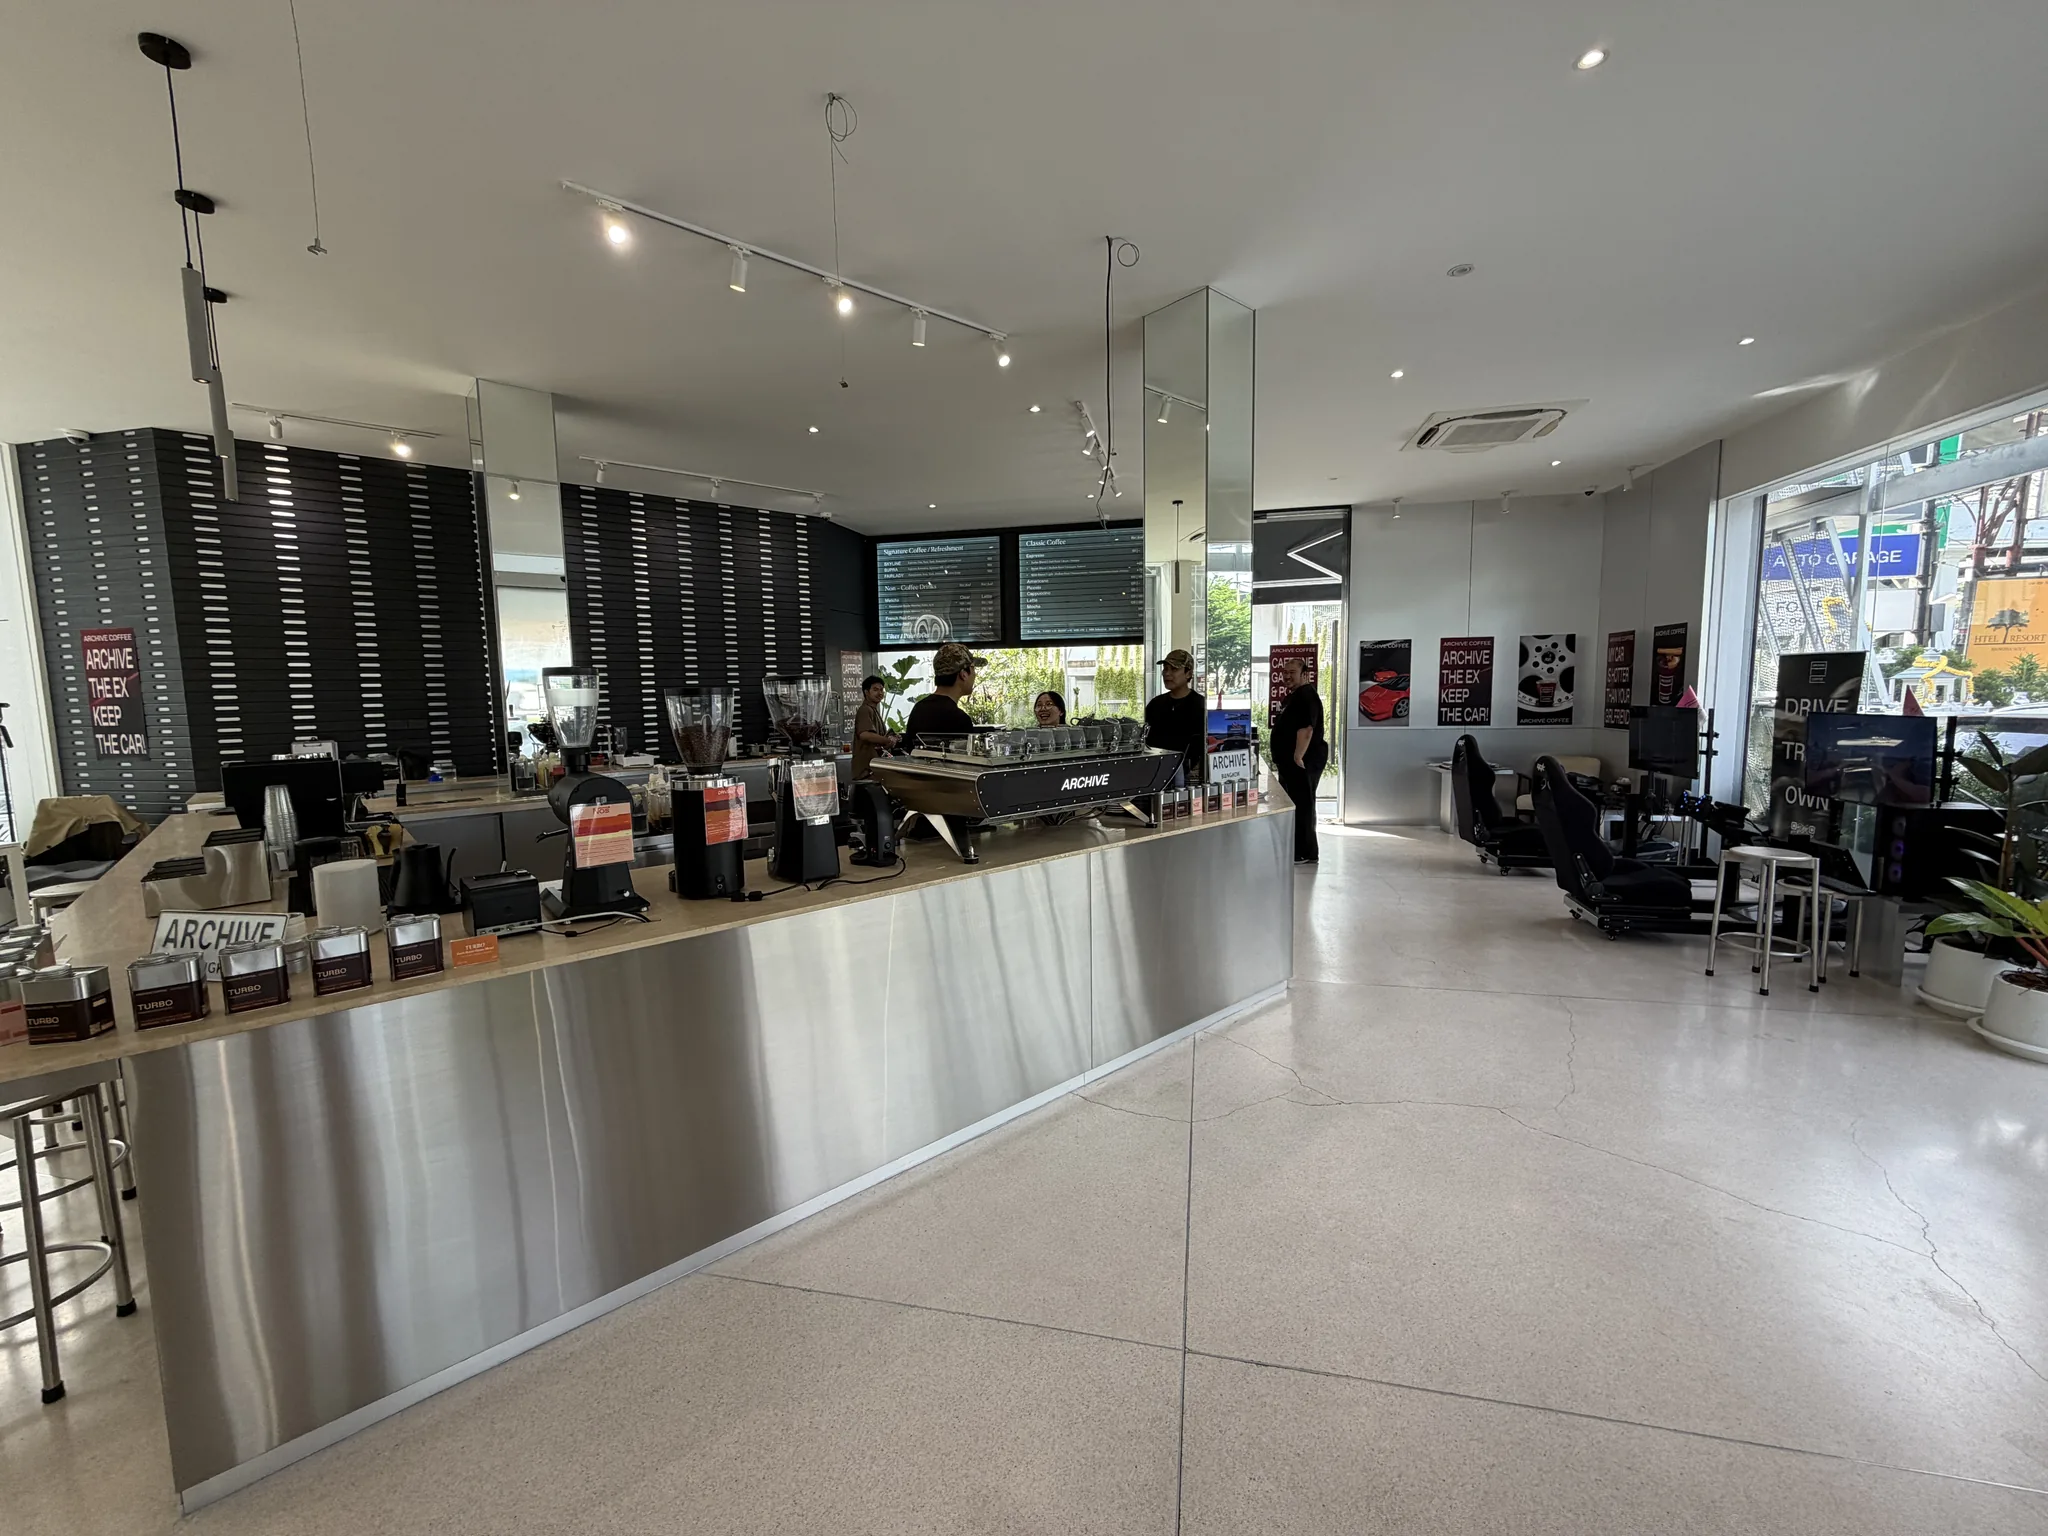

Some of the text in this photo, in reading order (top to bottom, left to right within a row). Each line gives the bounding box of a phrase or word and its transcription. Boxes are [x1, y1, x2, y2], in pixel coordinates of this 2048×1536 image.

[1025, 538, 1067, 547] Classic Coffee
[883, 548, 908, 556] Signature
[908, 546, 926, 554] Coffee
[1773, 553, 1821, 567] ATO
[108, 633, 132, 641] COFFEE
[1670, 627, 1686, 635] COFFEE
[2010, 633, 2047, 642] RESORT
[86, 647, 134, 670] ARCHIVE
[1442, 649, 1490, 665] ARCHIVE
[1441, 669, 1480, 684] THE EX
[88, 676, 129, 698] THE EX
[1271, 686, 1278, 698] &
[1441, 688, 1470, 703] KEEP
[1440, 707, 1489, 722] THE CAR!
[1785, 698, 1849, 717] DRIVE
[92, 705, 122, 727] KEEP
[95, 733, 148, 755] THE CAR!
[1212, 753, 1247, 770] ARCHIVE
[1061, 773, 1110, 791] ARCHIVE
[1785, 785, 1830, 811] OWN
[162, 918, 275, 950] ARCHIVE
[395, 953, 422, 964] TURBO
[316, 967, 347, 978] TURBO
[228, 984, 262, 996] TURBO
[137, 999, 174, 1011] TURBO
[27, 1016, 60, 1026] TURBO
